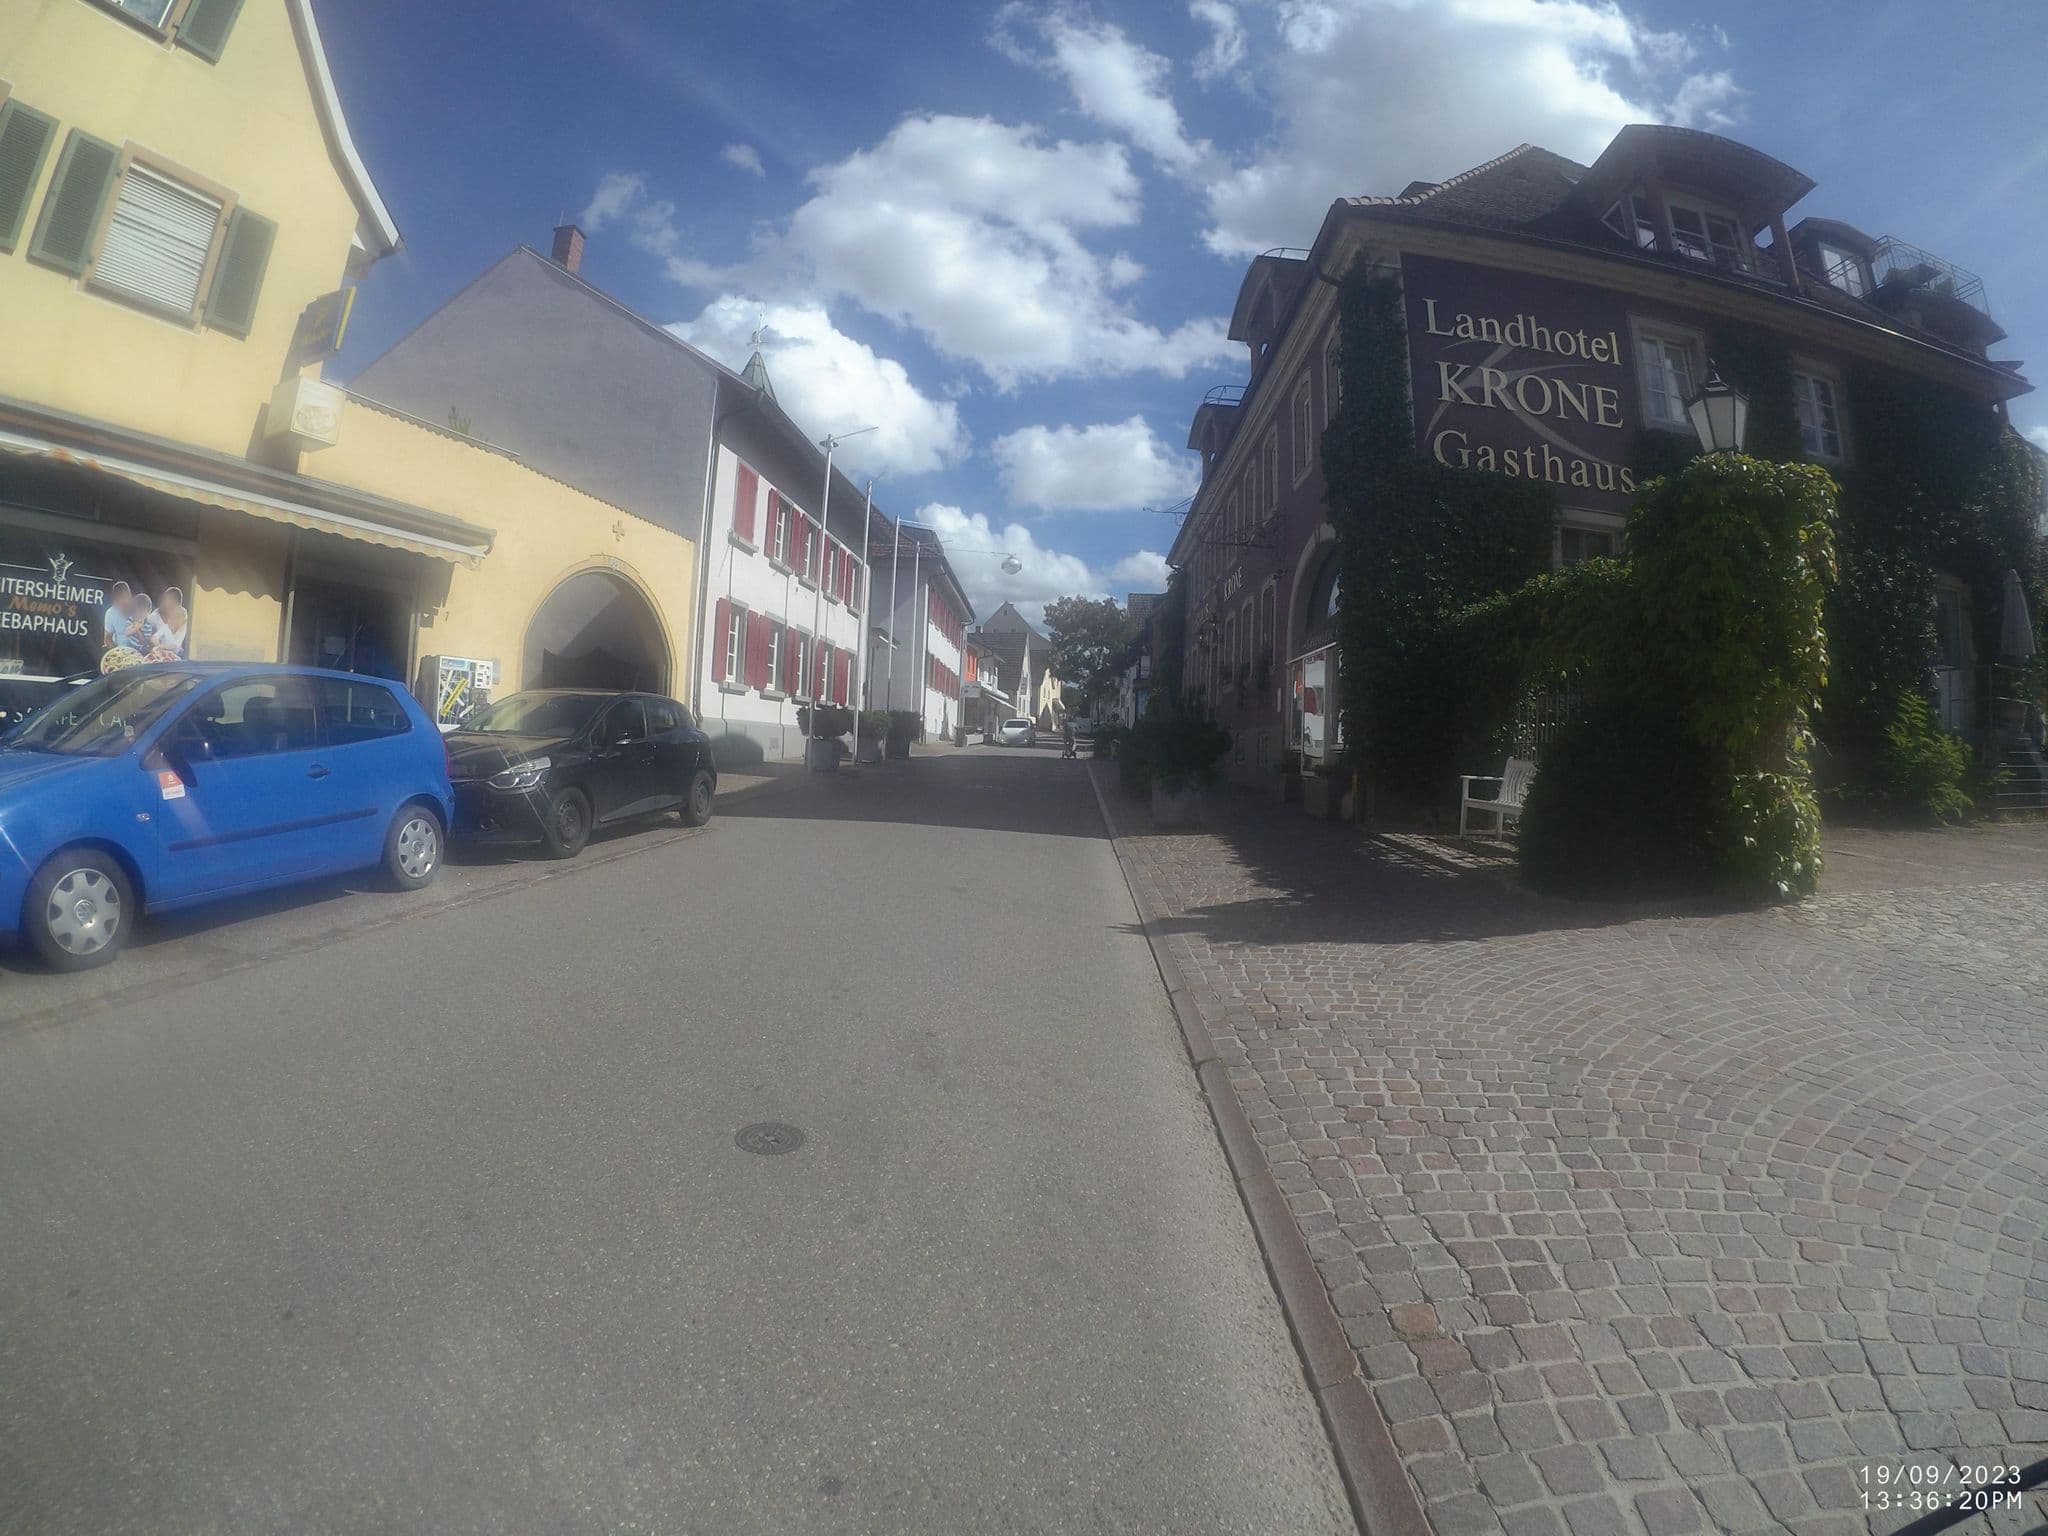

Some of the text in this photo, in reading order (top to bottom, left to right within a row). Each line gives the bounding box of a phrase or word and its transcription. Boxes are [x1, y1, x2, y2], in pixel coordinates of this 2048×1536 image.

[1423, 298, 1622, 366] Landhotel
[1434, 360, 1624, 429] KRONE
[1433, 429, 1637, 494] Gasthaus
[0, 576, 104, 605] ITERSHEIMER
[0, 611, 88, 637] EBAPHAUS
